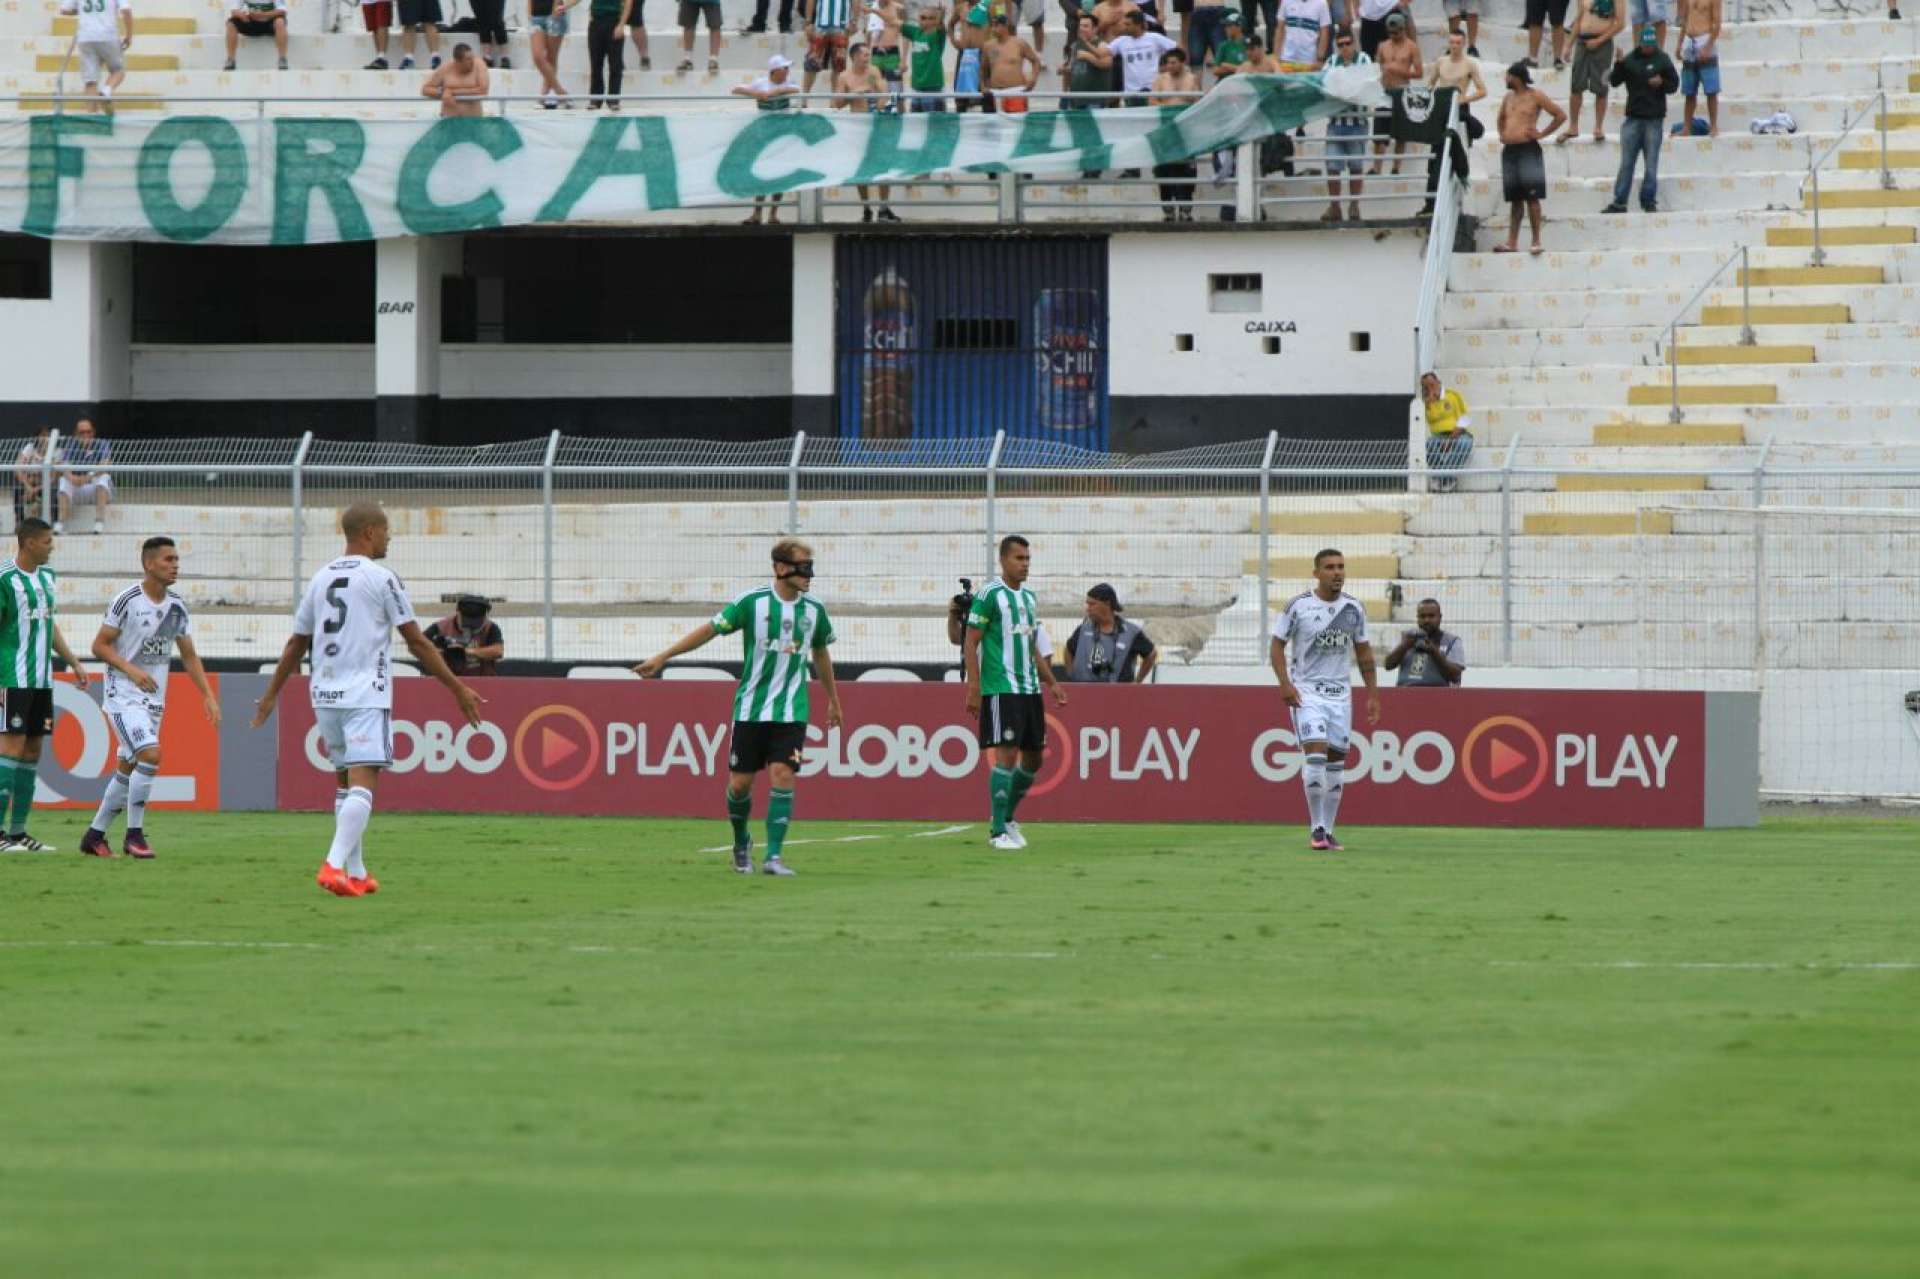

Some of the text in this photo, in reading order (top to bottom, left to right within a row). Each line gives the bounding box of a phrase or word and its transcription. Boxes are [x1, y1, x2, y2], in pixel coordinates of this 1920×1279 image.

[377, 301, 415, 314] BAR
[1244, 320, 1297, 334] CAIXA
[324, 577, 349, 634] 5
[606, 721, 727, 776] PLAY
[1079, 727, 1201, 781] PLAY
[1250, 728, 1678, 788] GOBO PLAY
